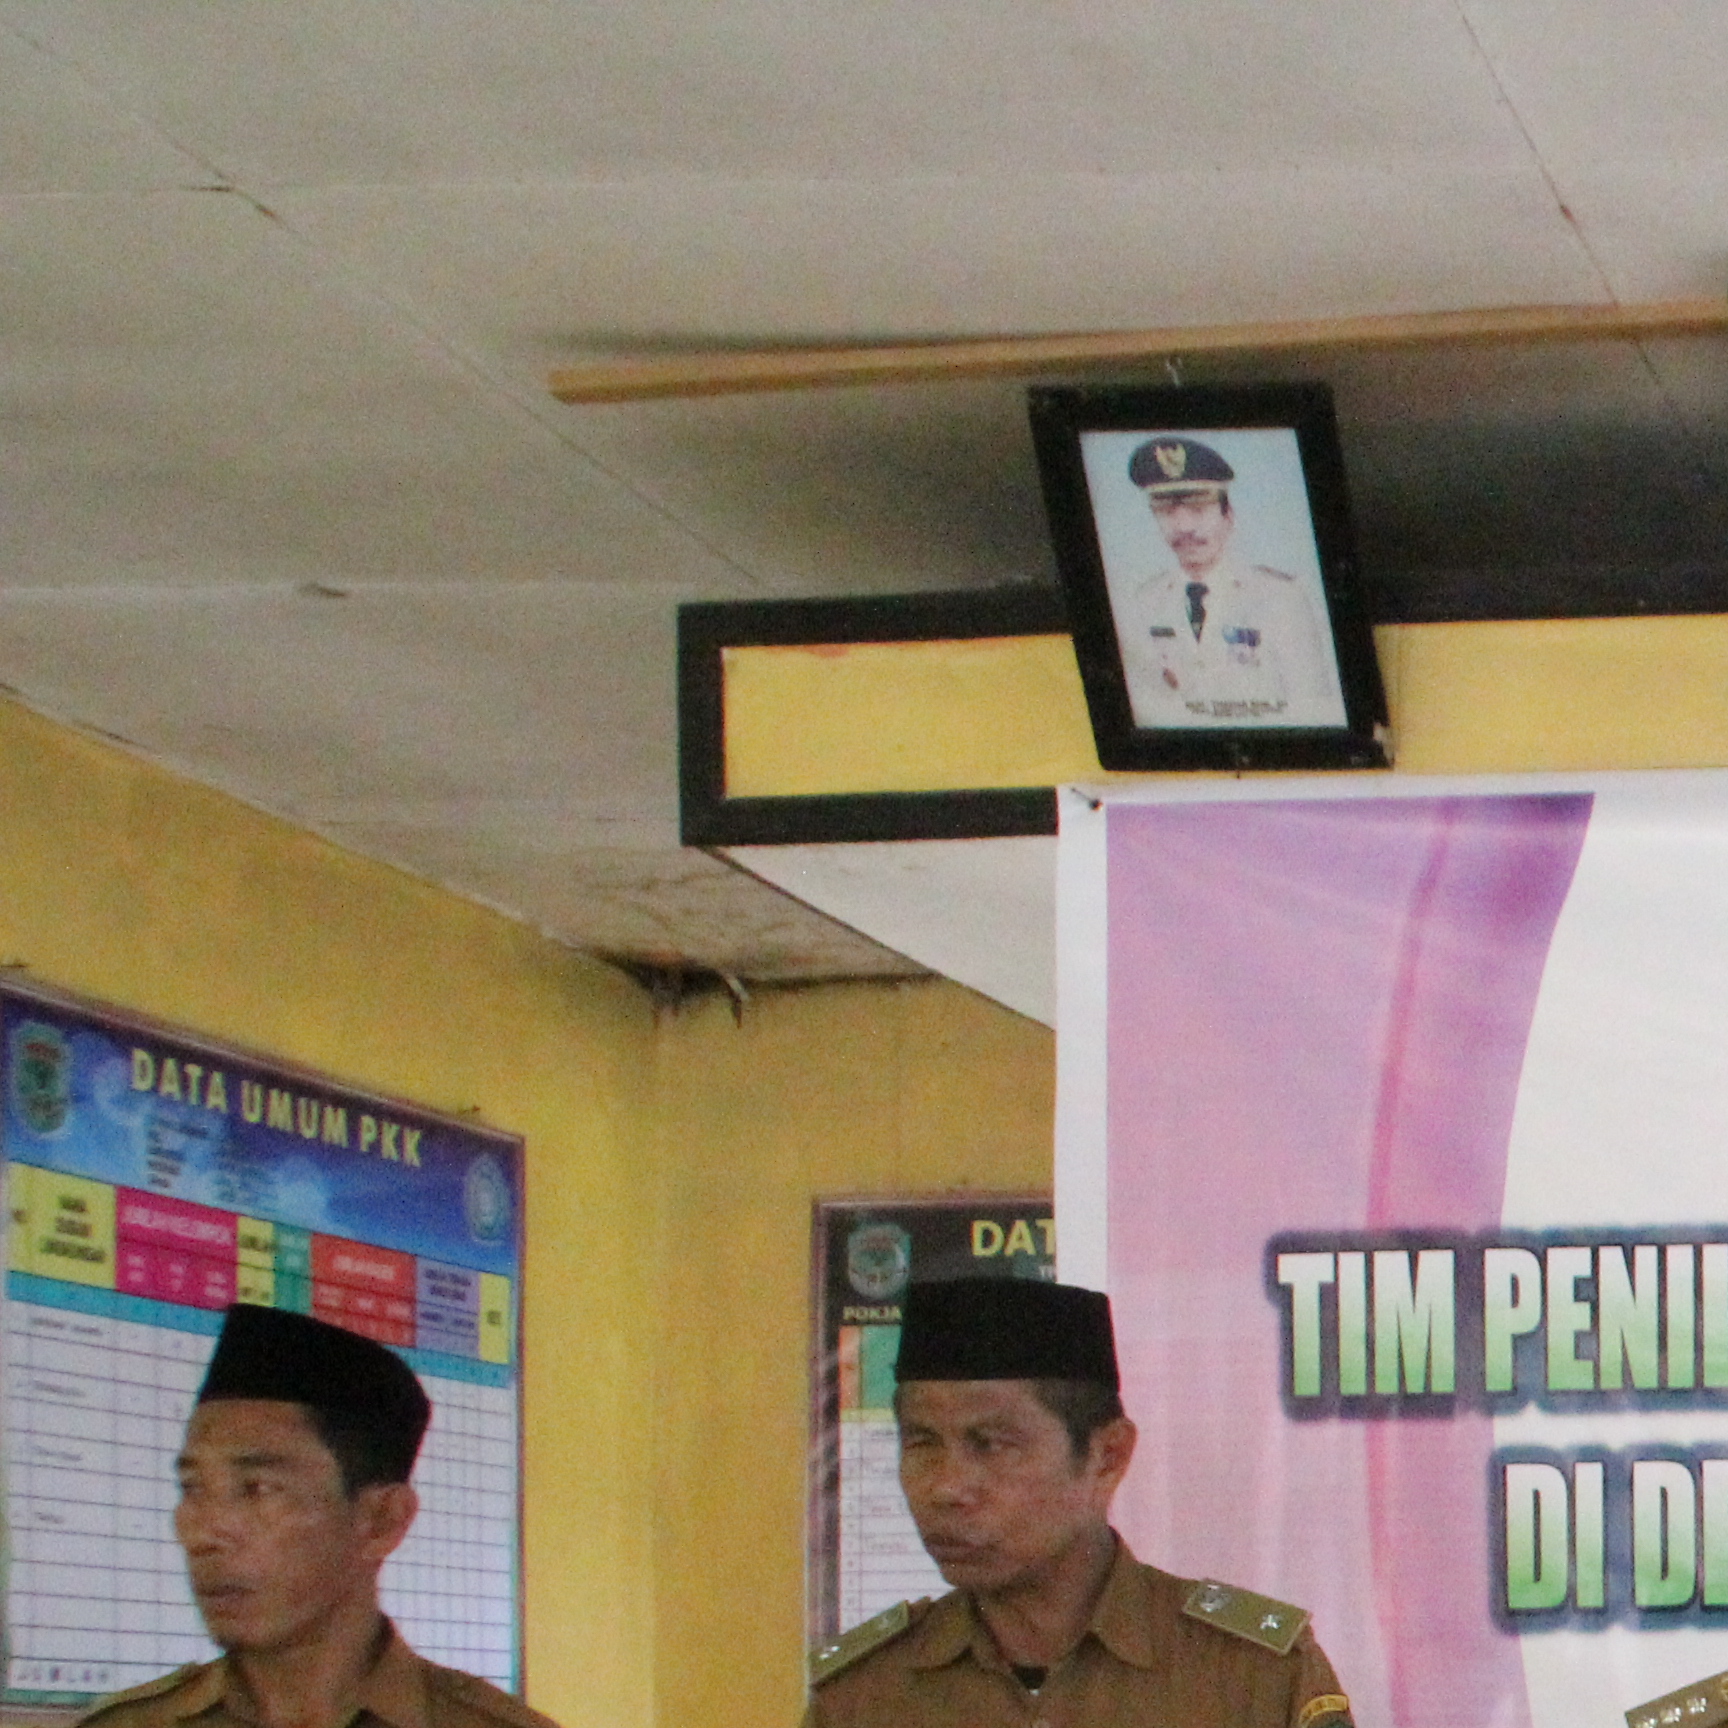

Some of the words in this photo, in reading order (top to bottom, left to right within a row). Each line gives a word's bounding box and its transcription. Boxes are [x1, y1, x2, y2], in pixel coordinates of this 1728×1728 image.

[131, 1047, 229, 1114] DATA
[240, 1079, 349, 1149] UMUM
[359, 1114, 423, 1168] PKK
[970, 1218, 1057, 1258] DAT
[1277, 1248, 1456, 1397] TIM
[1505, 1459, 1606, 1611] DI
